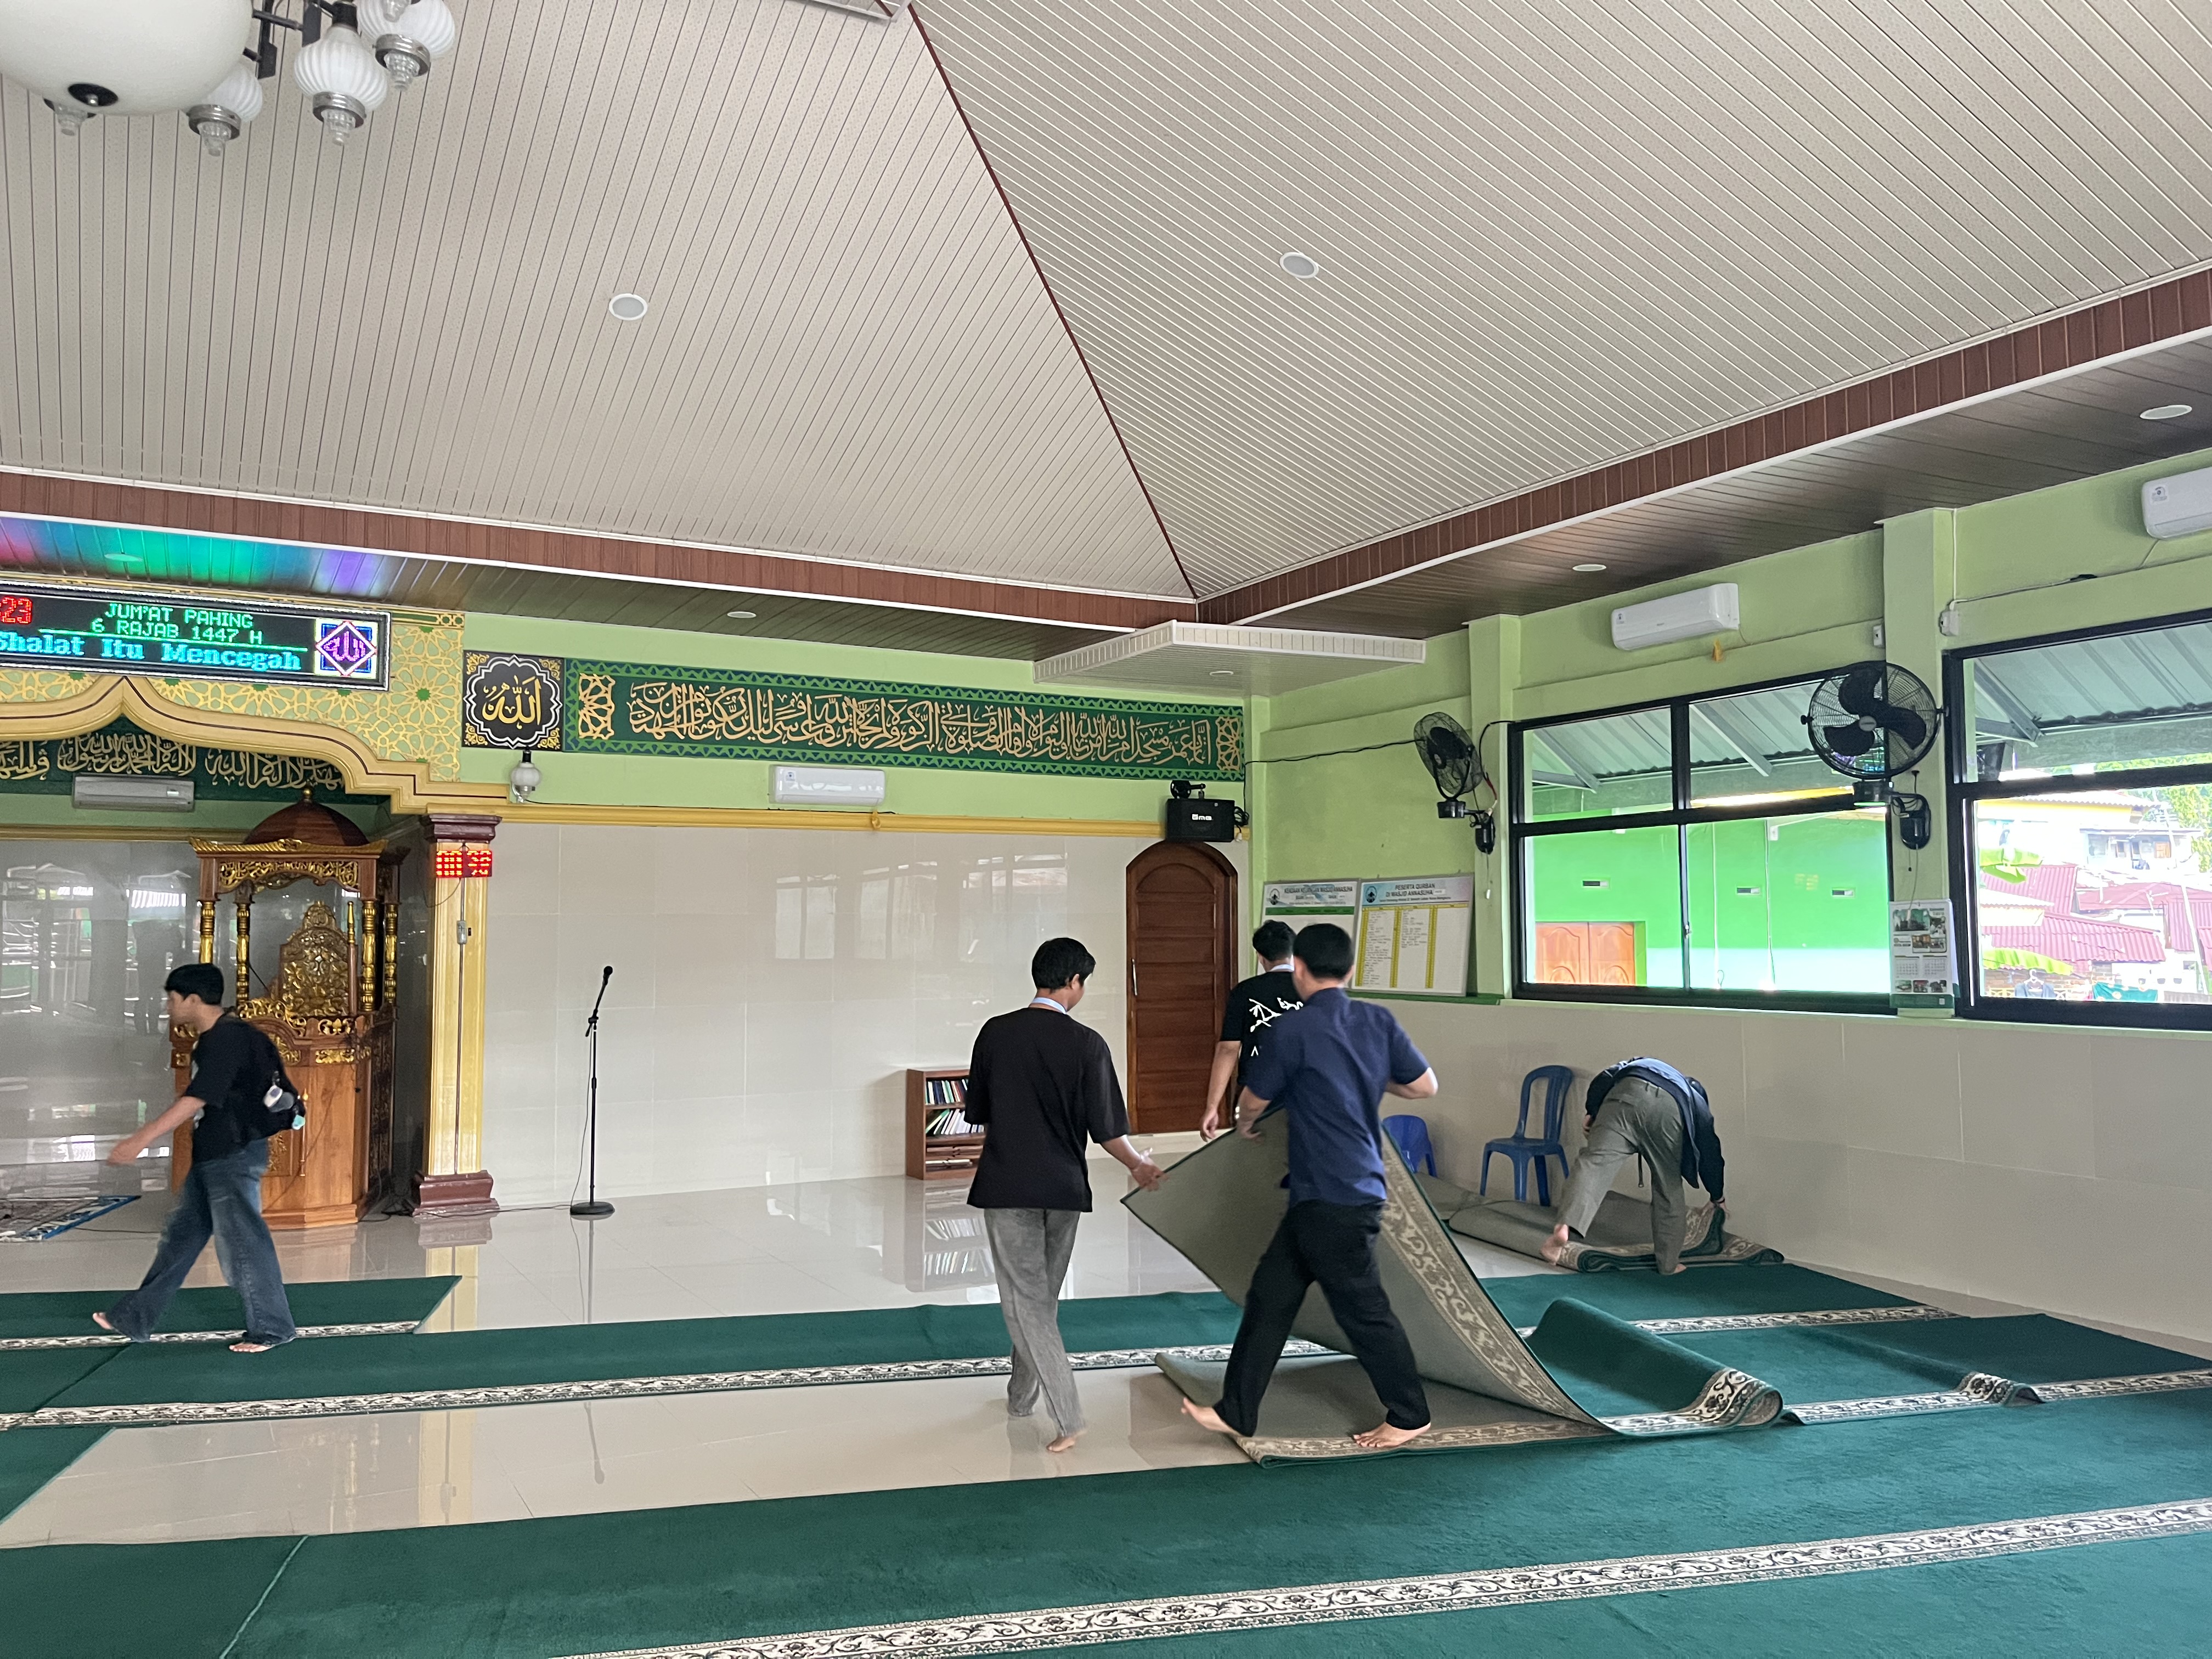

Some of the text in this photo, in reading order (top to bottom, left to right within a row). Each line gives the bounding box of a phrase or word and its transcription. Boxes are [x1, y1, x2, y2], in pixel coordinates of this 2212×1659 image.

[91, 617, 263, 645] 6 RAJAB 1447 H
[184, 608, 253, 628] PAHING
[101, 638, 145, 660] Itu
[161, 642, 302, 672] Mencegah
